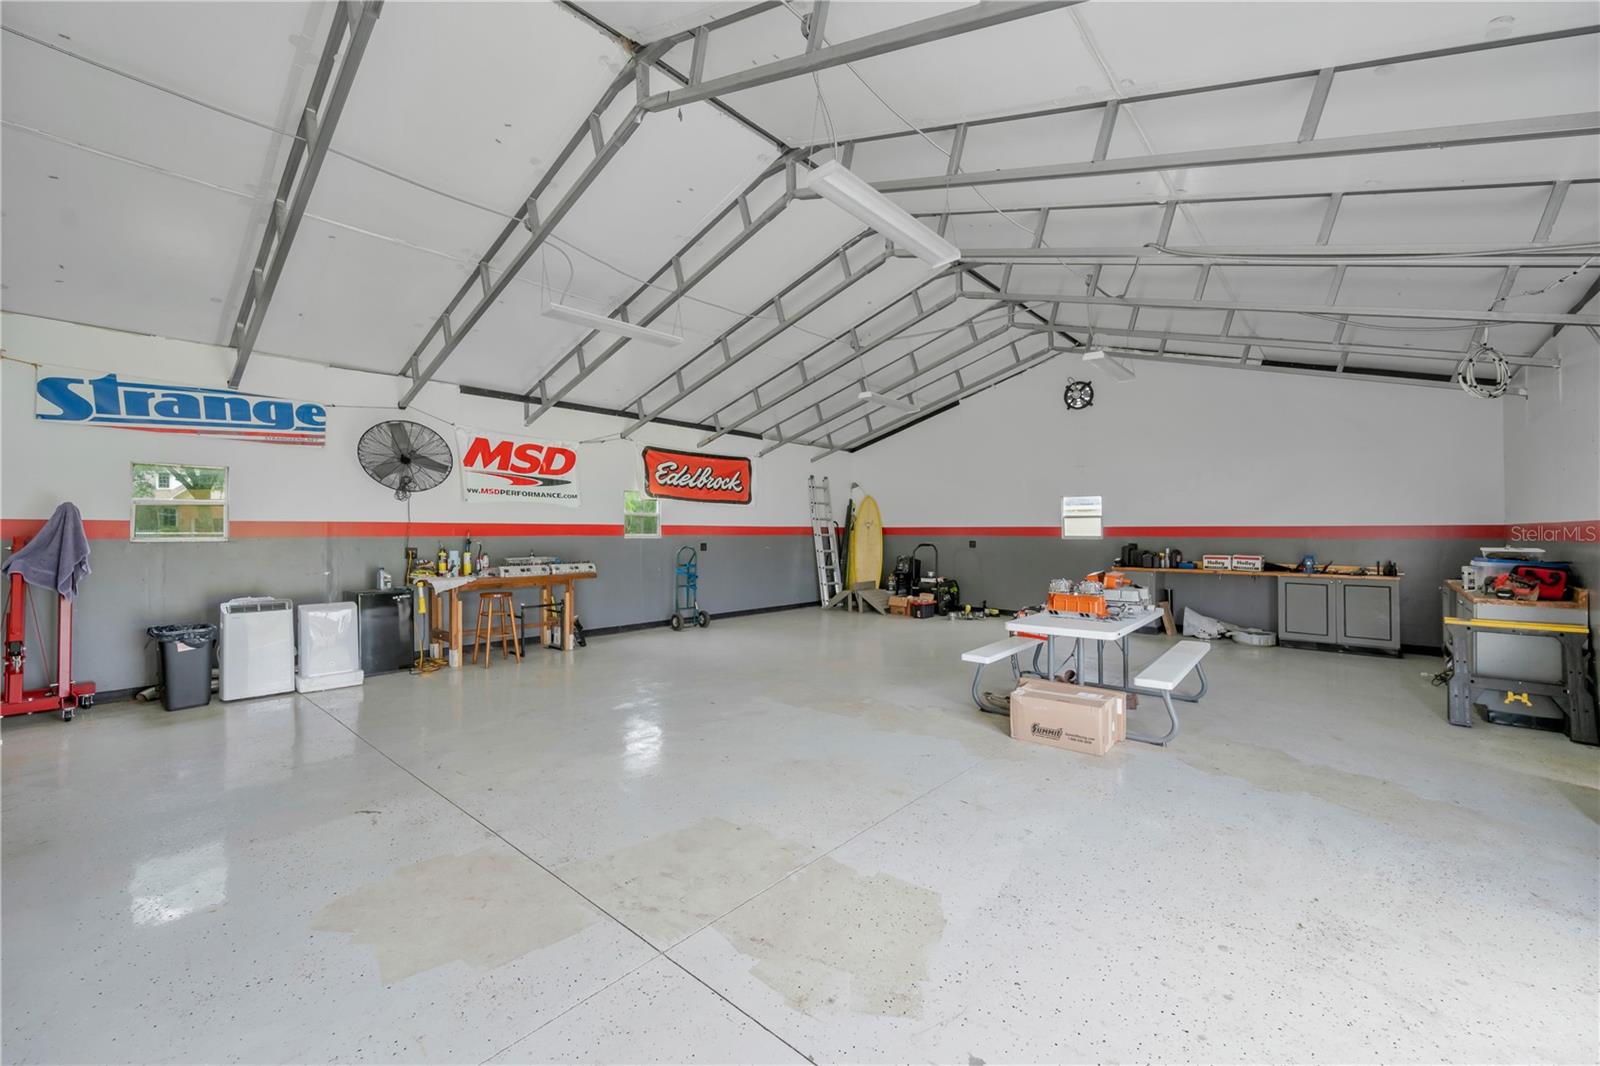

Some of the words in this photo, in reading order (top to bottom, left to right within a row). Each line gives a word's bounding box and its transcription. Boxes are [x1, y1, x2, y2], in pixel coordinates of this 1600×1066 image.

[36, 373, 326, 430] Strange
[463, 437, 576, 475] MSD
[655, 461, 743, 492] Edelbrock
